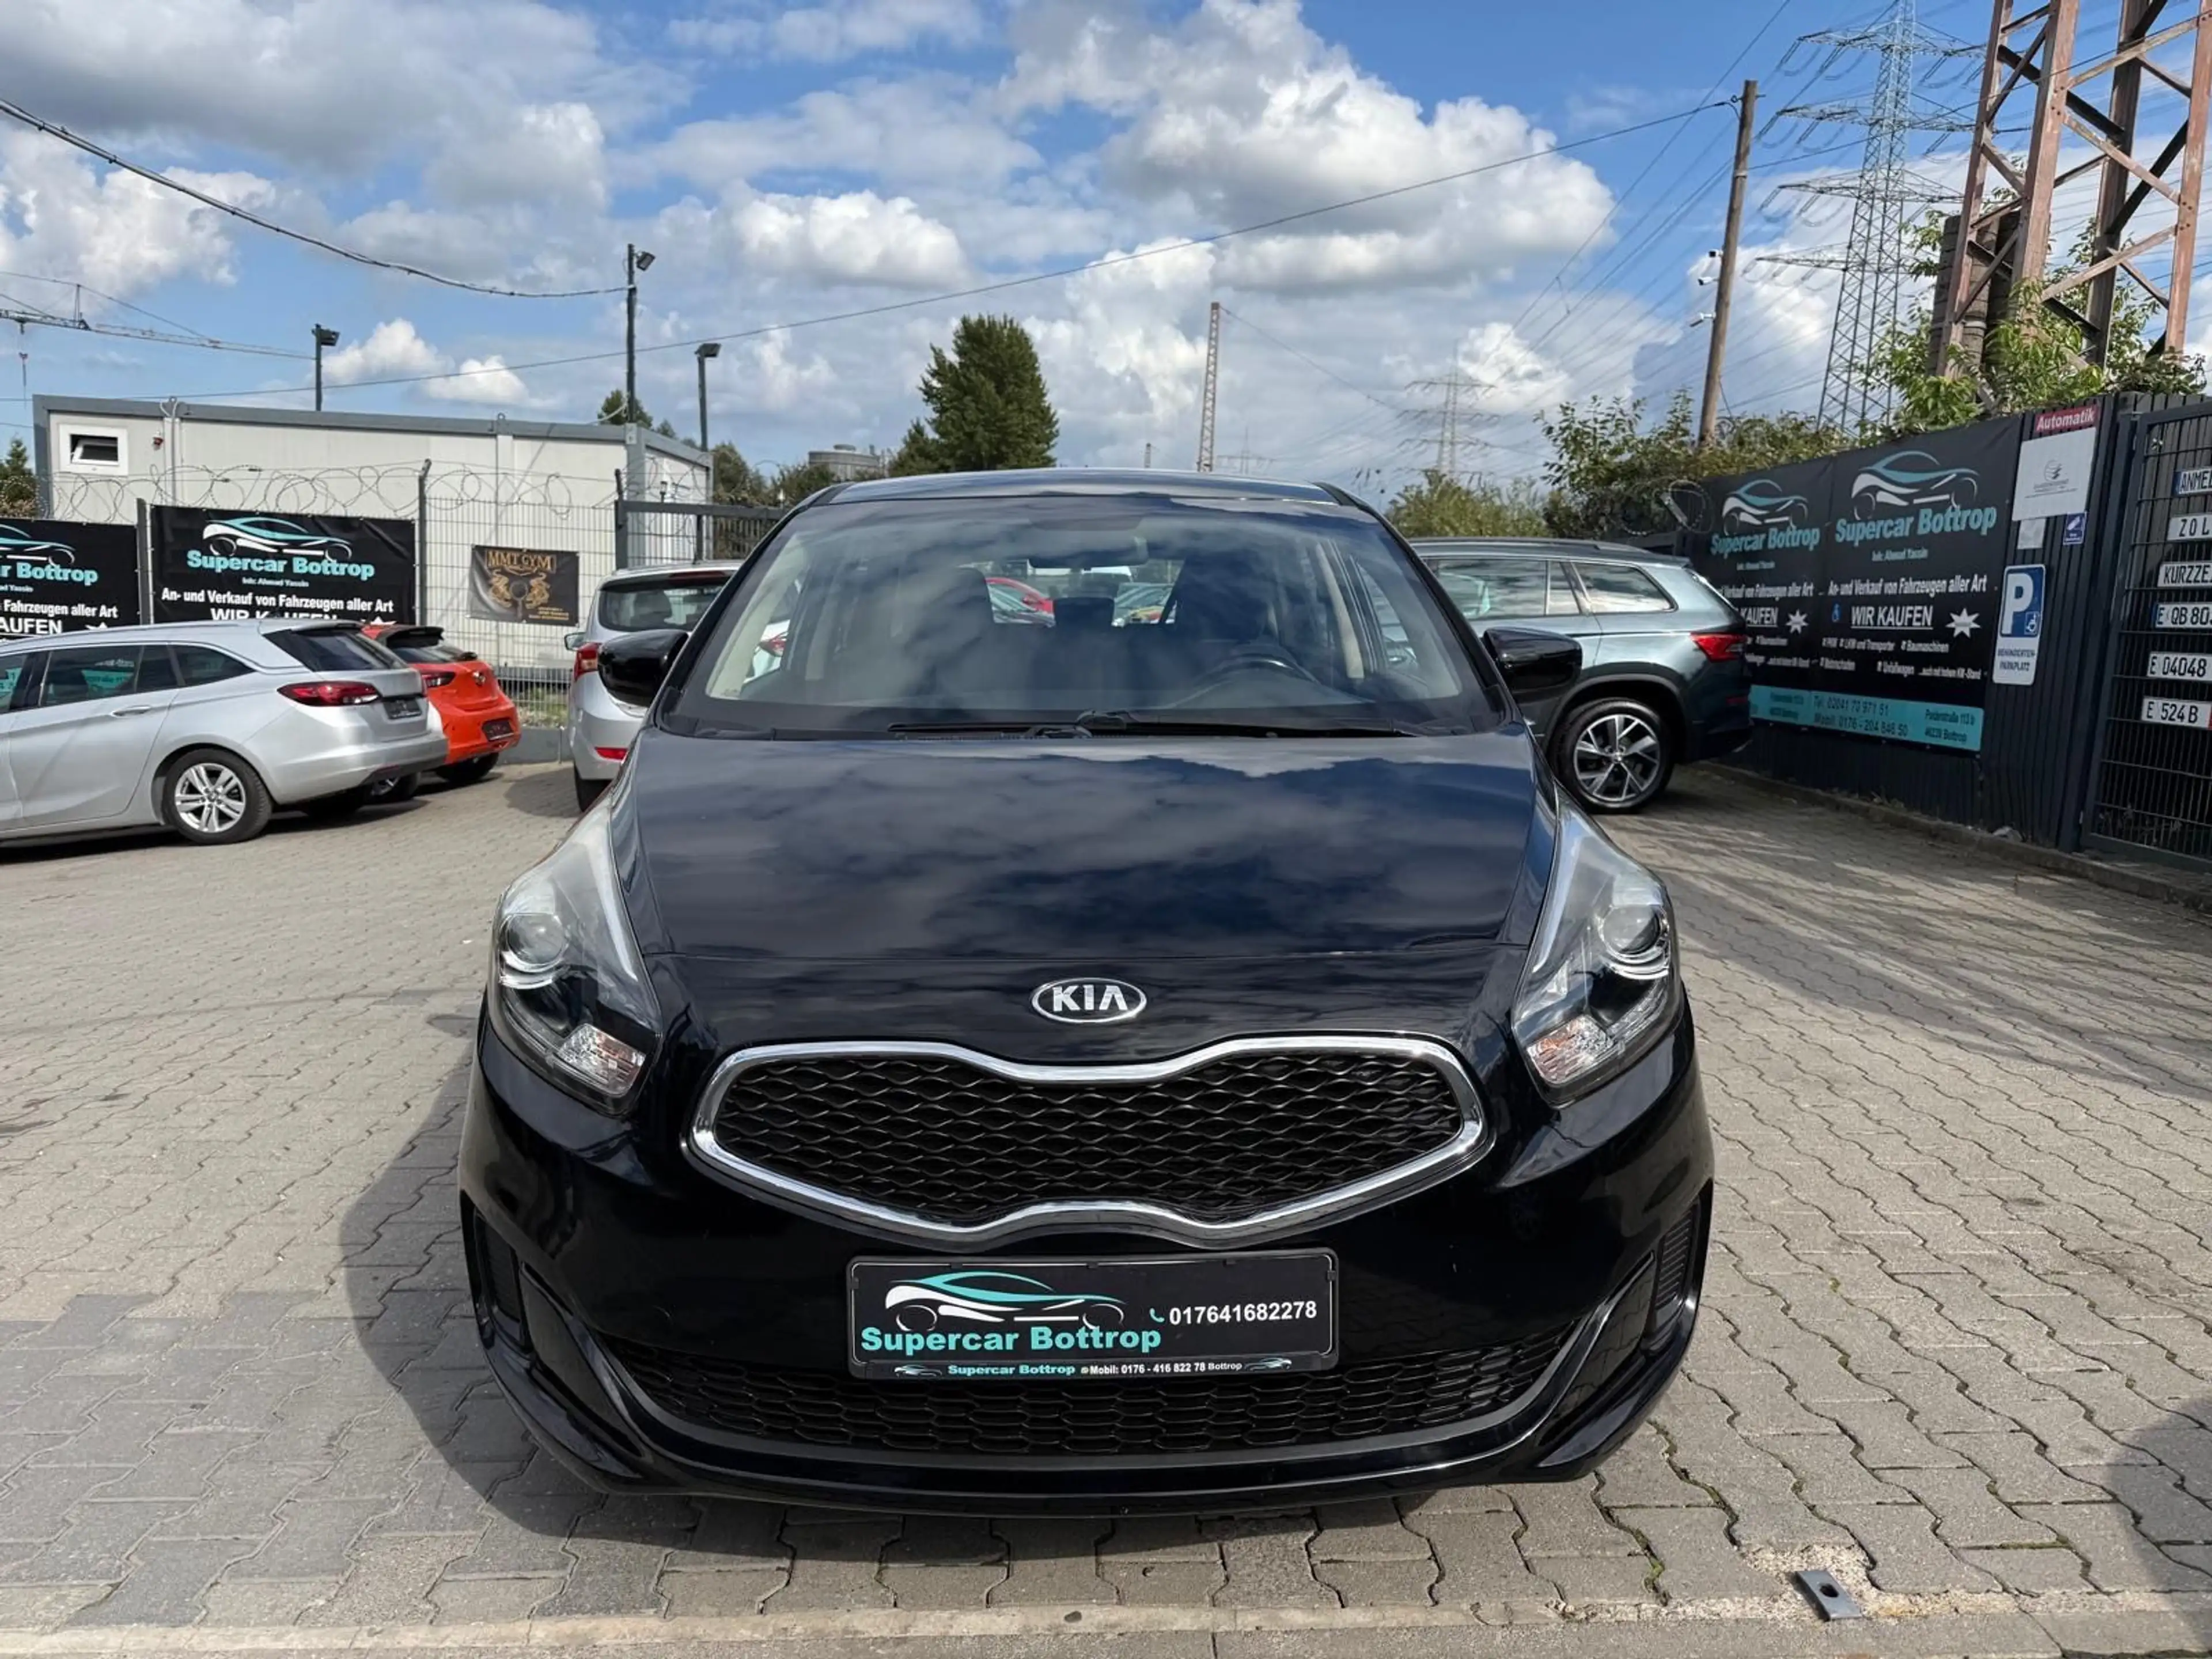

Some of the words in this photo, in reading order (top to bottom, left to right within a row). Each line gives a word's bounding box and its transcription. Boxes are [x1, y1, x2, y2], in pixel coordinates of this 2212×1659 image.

[2036, 408, 2095, 431] Automatik
[1835, 516, 1915, 547] Supercar
[1916, 504, 1998, 536] Bottrop
[1710, 533, 1766, 559] Supercar
[1767, 527, 1820, 551] Bottrop
[17, 562, 99, 586] Bottrop
[187, 550, 287, 572] Supercar
[292, 556, 376, 580] Bottrop
[2164, 565, 2211, 584] KURZZE
[1854, 578, 1884, 596] Verkauf
[1884, 582, 1897, 594] von
[1899, 577, 1947, 598] Fahrzeugen
[1948, 575, 1969, 593] aller
[1970, 574, 1987, 593] Art
[3, 599, 68, 618] Fahrzeugen
[70, 603, 97, 617] aller
[99, 605, 119, 619] Art
[162, 588, 181, 601] An-
[184, 590, 205, 603] und
[207, 591, 253, 605] Verkauf
[255, 595, 276, 606] von
[279, 594, 344, 612] Fahrzeugen
[346, 599, 373, 611] aller
[375, 599, 393, 613] Art
[1851, 606, 1875, 626] WIR
[1876, 605, 1934, 626] KAUFEN
[2191, 607, 2212, 626] 80
[1053, 984, 1128, 1012] KIA
[1169, 1300, 1318, 1325] 017641682278
[860, 1326, 1019, 1355] Supercar
[1031, 1325, 1162, 1353] Bottrop
[948, 1363, 1015, 1376] Supercar
[1018, 1364, 1075, 1376] Bottrop
[1090, 1365, 1119, 1374] Mobil:
[1120, 1364, 1145, 1374] 0176
[1153, 1363, 1171, 1373] 416
[1173, 1362, 1191, 1373] 822
[1194, 1362, 1206, 1372] 78
[1207, 1361, 1243, 1371] Bottrop
